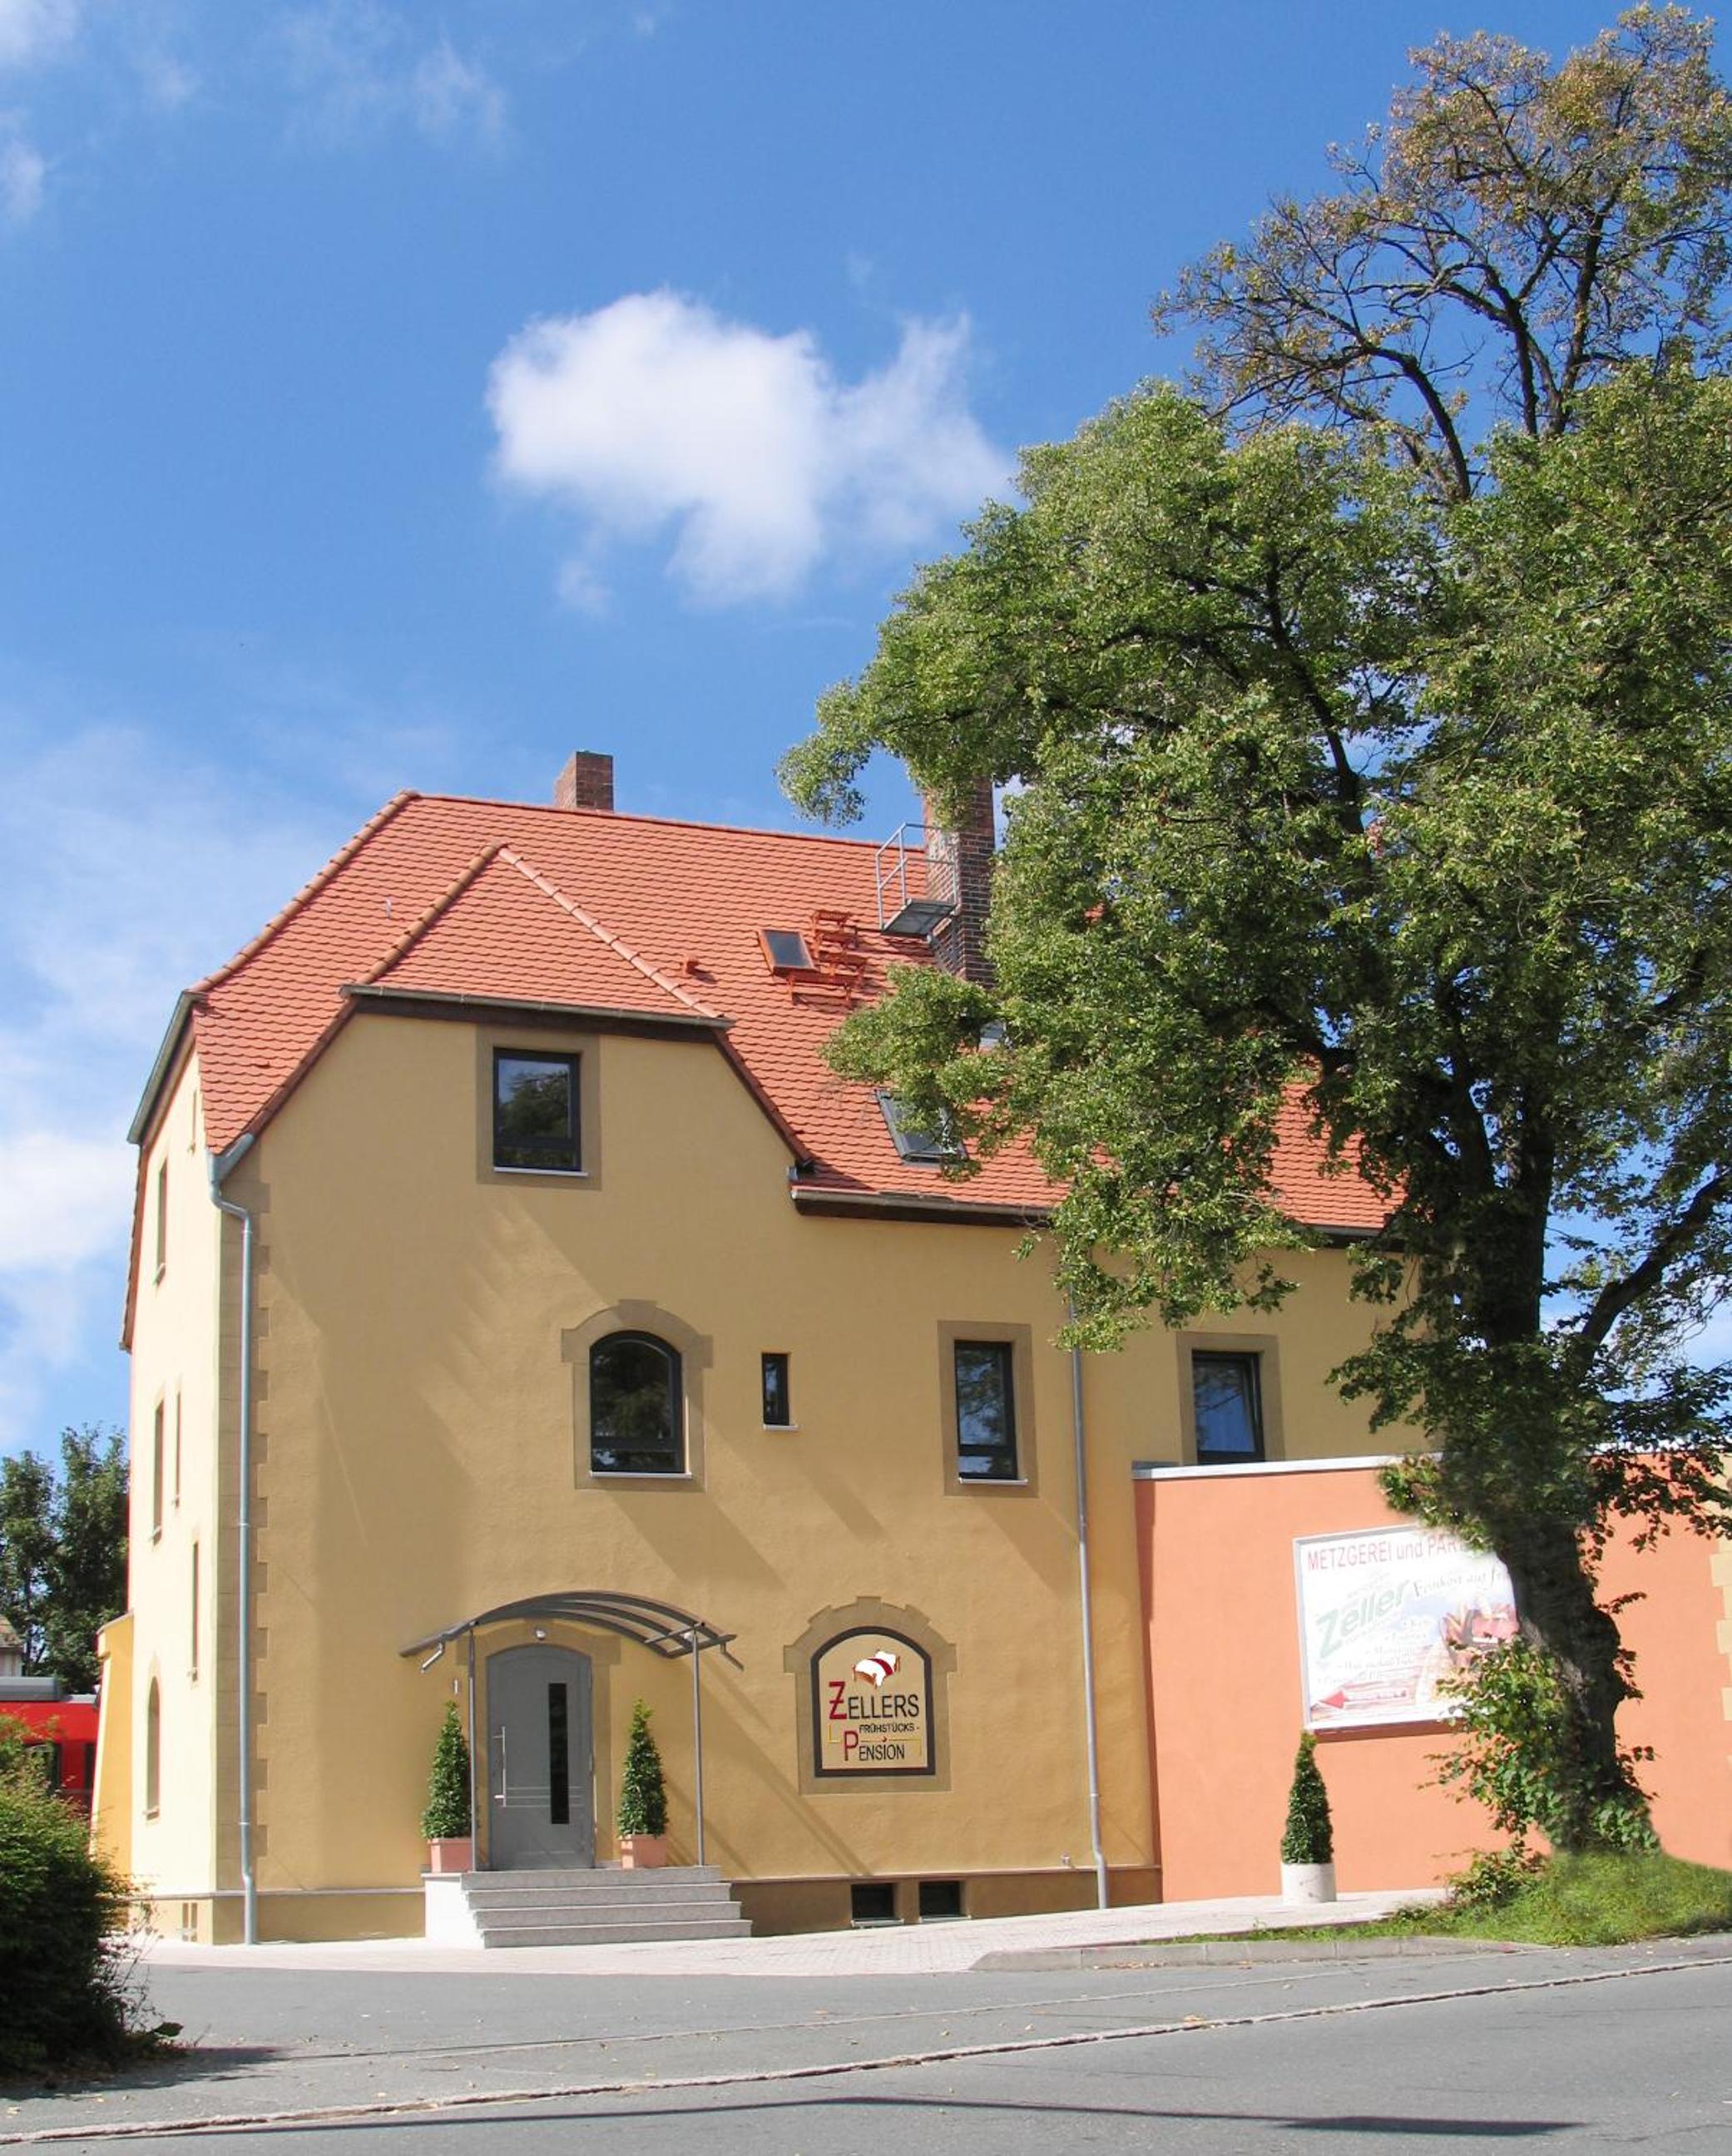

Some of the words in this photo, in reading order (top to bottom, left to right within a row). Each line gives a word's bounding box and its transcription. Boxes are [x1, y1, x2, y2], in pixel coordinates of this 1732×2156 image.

[1307, 1540, 1392, 1570] METZGEREI
[1397, 1540, 1423, 1560] und
[1427, 1535, 1466, 1557] PAR
[1315, 1579, 1410, 1659] Zeller
[829, 1681, 919, 1720] ZELLERS
[844, 1730, 905, 1762] PENSION
